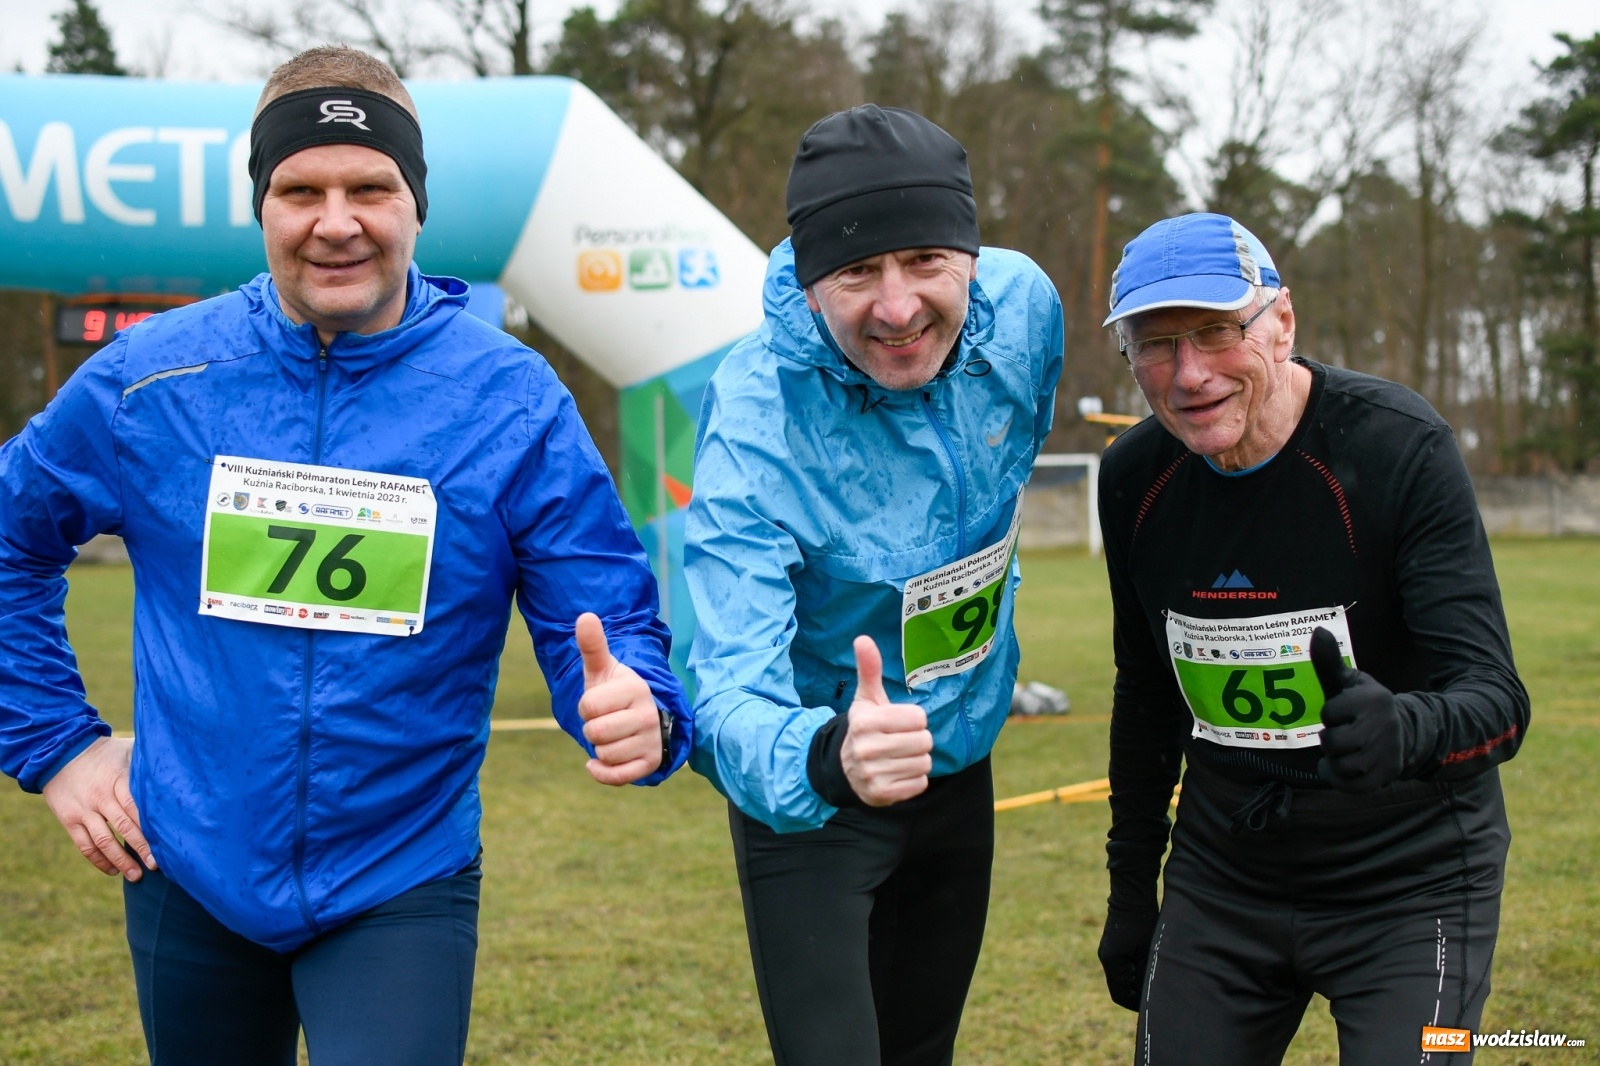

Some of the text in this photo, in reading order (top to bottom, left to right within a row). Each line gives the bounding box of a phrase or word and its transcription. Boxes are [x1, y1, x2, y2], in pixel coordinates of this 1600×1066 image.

[227, 463, 427, 494] VIII Kuźniański Półmaraton Leśny RAFAMET
[243, 478, 408, 504] Kuźnia Raciborska, 1 kwietnia 2023 r.
[315, 506, 349, 517] RAFAMET
[266, 525, 367, 601] 76
[908, 580, 922, 589] VIII
[923, 562, 967, 584] Kuźniański
[923, 580, 950, 592] Kuźnia
[951, 561, 992, 583] Raciborska,
[1192, 591, 1277, 599] HENDERSON
[1183, 621, 1217, 632] Kuźniański
[1217, 624, 1264, 632] Półmaraton
[1265, 620, 1289, 630] Leśny
[1290, 612, 1335, 626] RAFAMET
[1204, 633, 1248, 642] Raciborska,
[1254, 629, 1290, 641] kwietnia
[1291, 626, 1313, 637] 2023
[1222, 668, 1306, 725] 65
